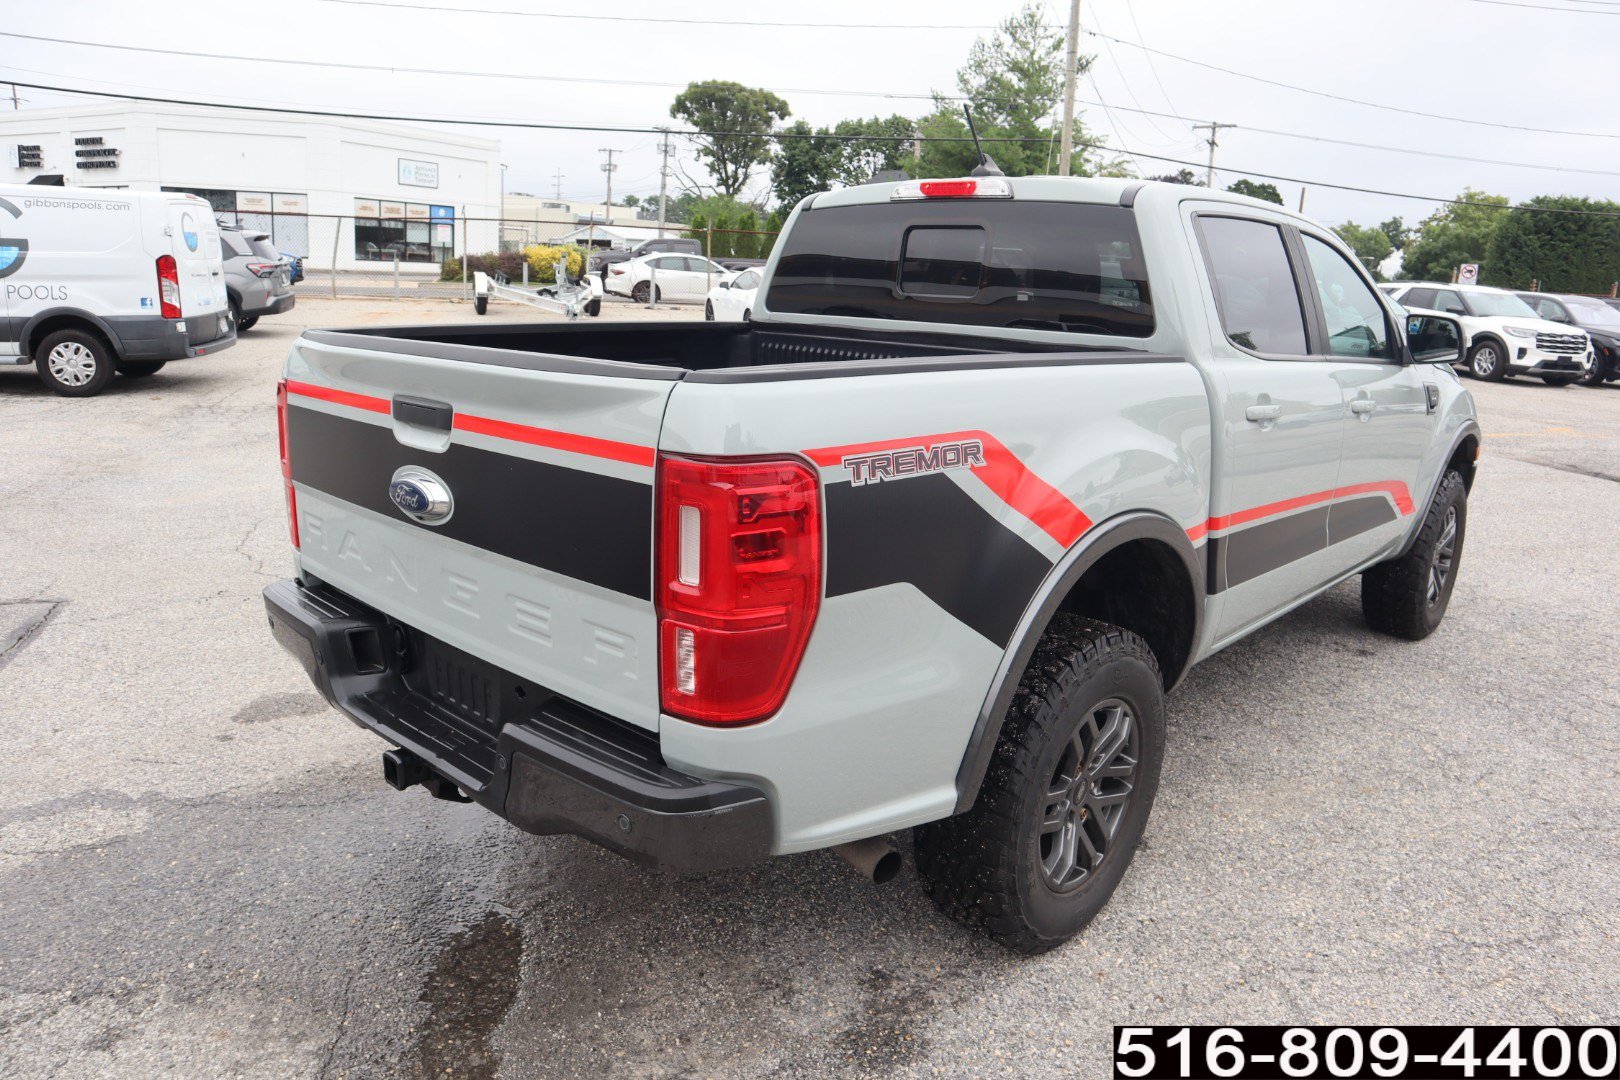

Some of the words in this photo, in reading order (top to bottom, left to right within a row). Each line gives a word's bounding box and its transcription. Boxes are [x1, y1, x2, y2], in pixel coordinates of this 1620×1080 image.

[24, 199, 130, 211] gibbonspools.com
[7, 285, 68, 301] POOLS
[842, 441, 986, 487] TREMOR
[395, 484, 419, 508] Ford
